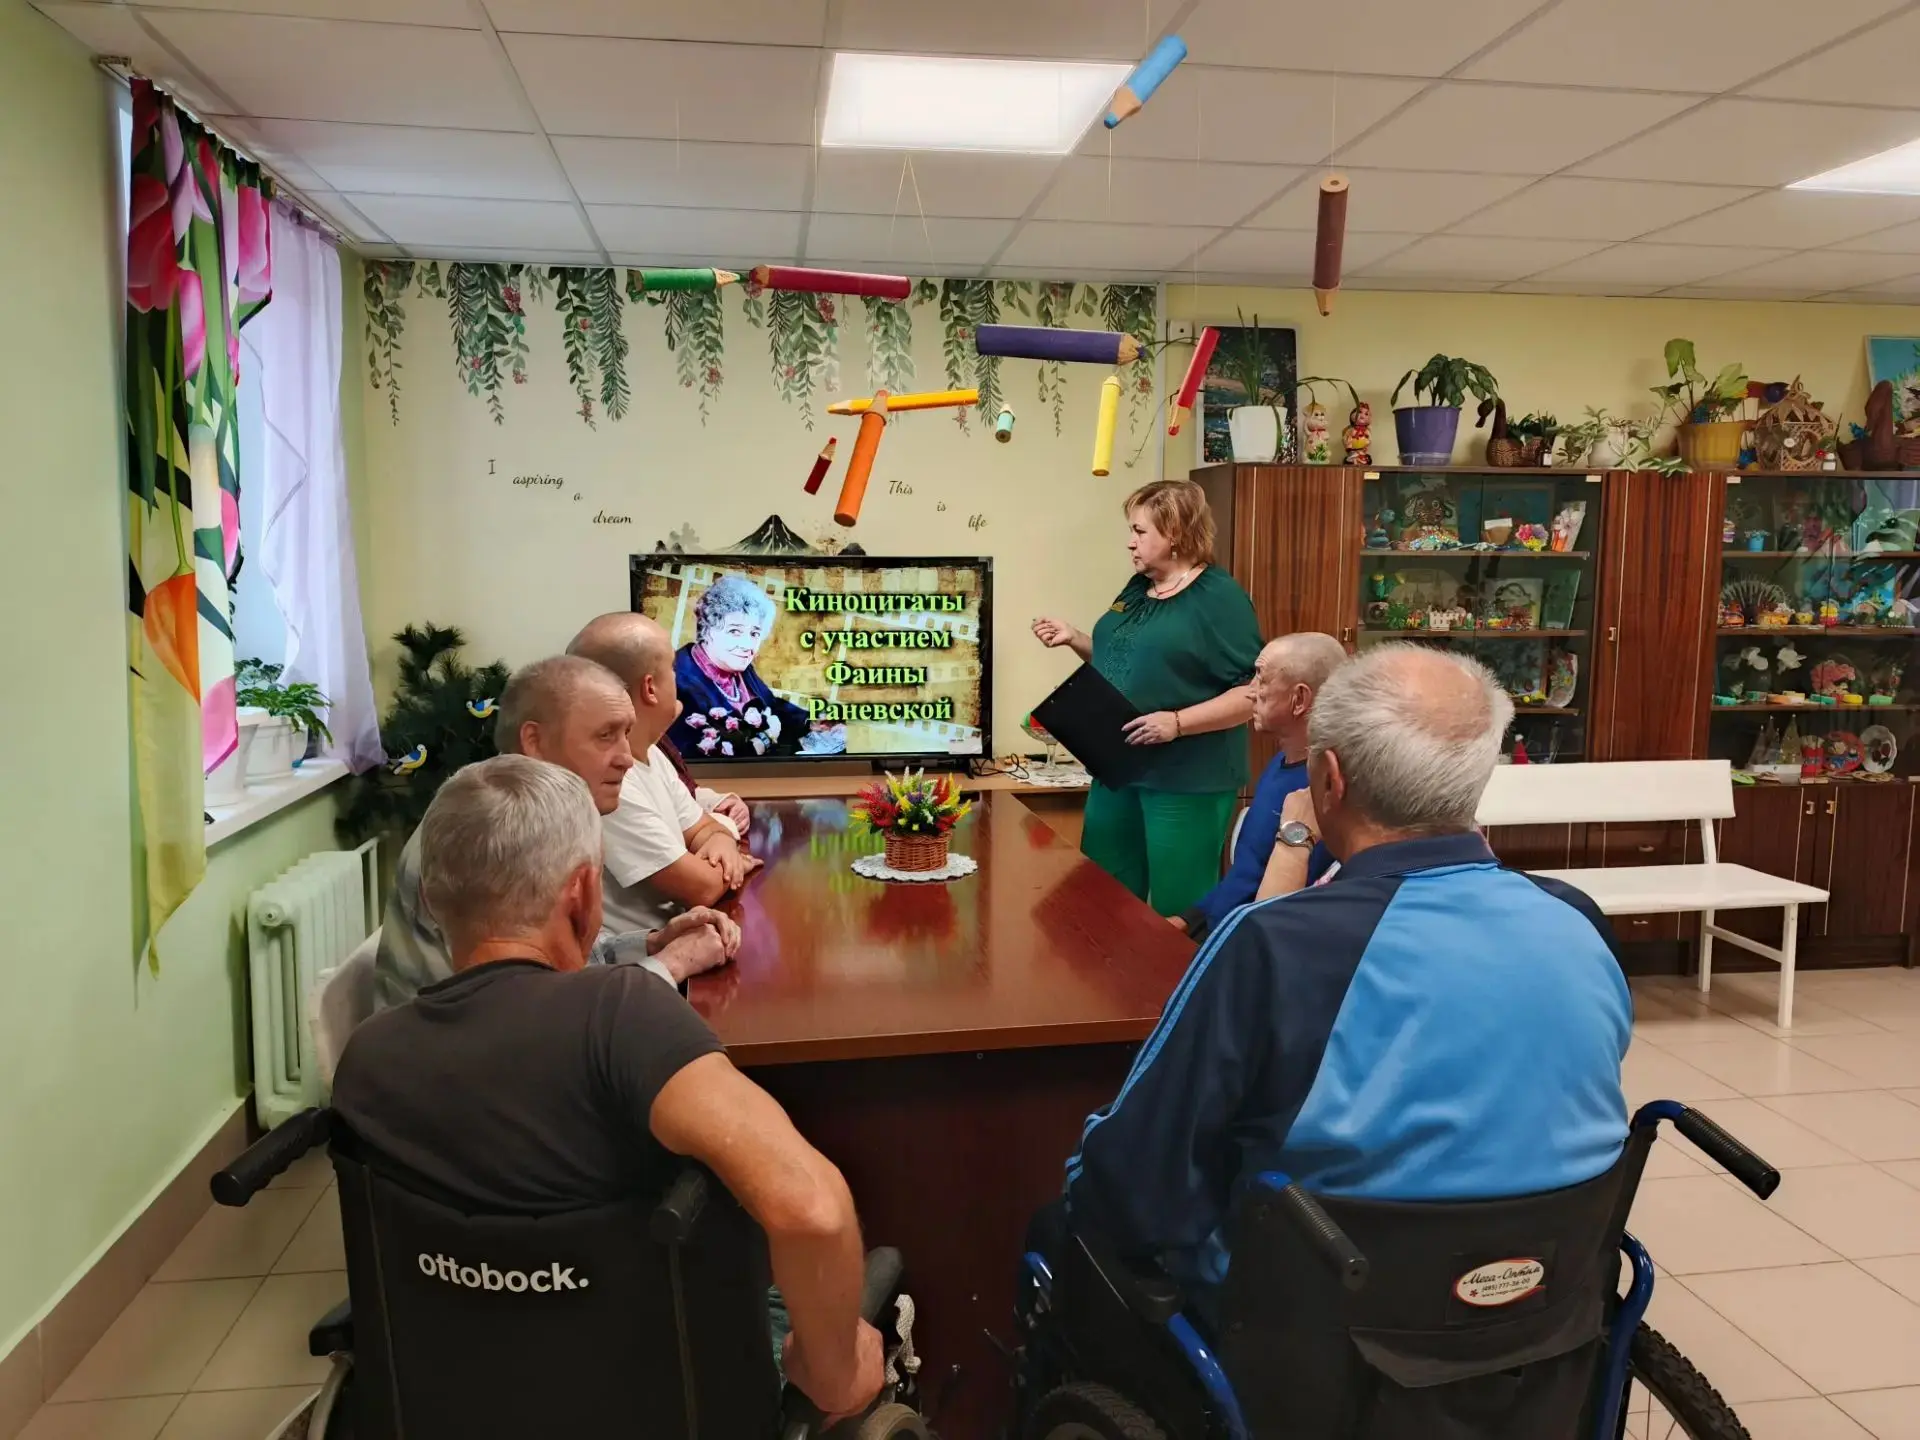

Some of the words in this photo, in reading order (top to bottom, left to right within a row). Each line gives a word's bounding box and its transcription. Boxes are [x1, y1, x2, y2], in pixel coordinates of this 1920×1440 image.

[488, 459, 496, 475] I
[512, 474, 564, 489] aspiring
[573, 492, 583, 501] a
[592, 510, 632, 524] dream
[889, 480, 913, 495] This
[937, 501, 947, 512] is
[968, 514, 986, 531] life
[785, 588, 964, 614] Киноцитаты
[800, 631, 814, 648] с
[822, 630, 951, 654] участием
[825, 661, 926, 684] Фаины
[808, 696, 952, 721] Раневской
[418, 1253, 589, 1293] ottobock.
